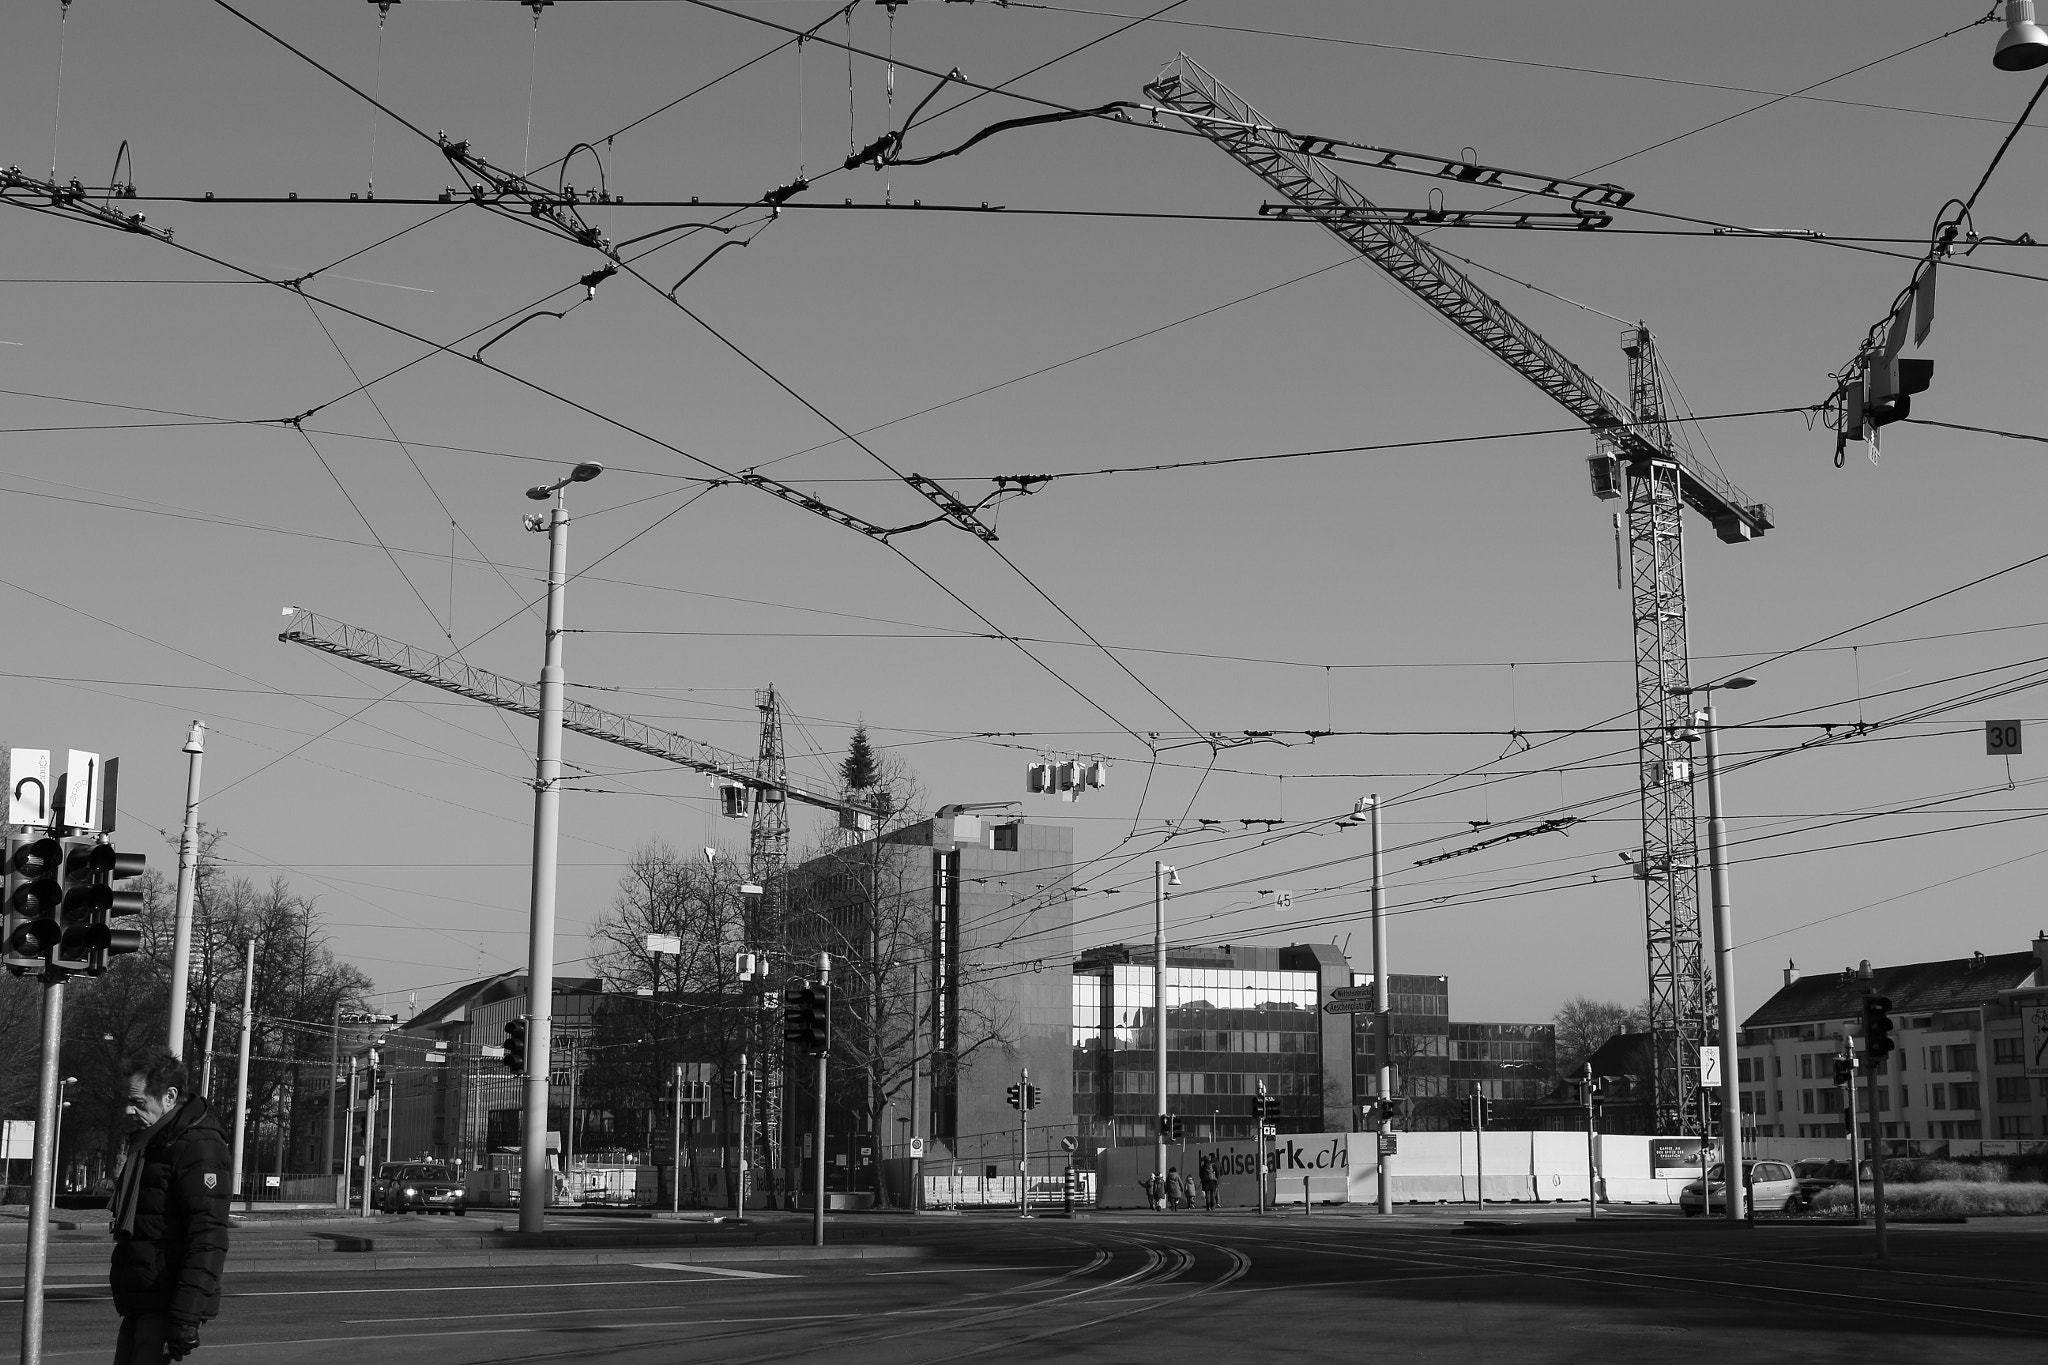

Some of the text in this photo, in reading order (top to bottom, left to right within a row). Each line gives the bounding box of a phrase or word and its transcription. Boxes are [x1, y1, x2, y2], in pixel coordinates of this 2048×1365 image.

[1990, 726, 2018, 748] 30
[1653, 763, 1660, 781] 1
[1676, 763, 1684, 780] 1
[1277, 894, 1291, 907] 45
[1198, 1138, 1349, 1181] bloiseark.ch
